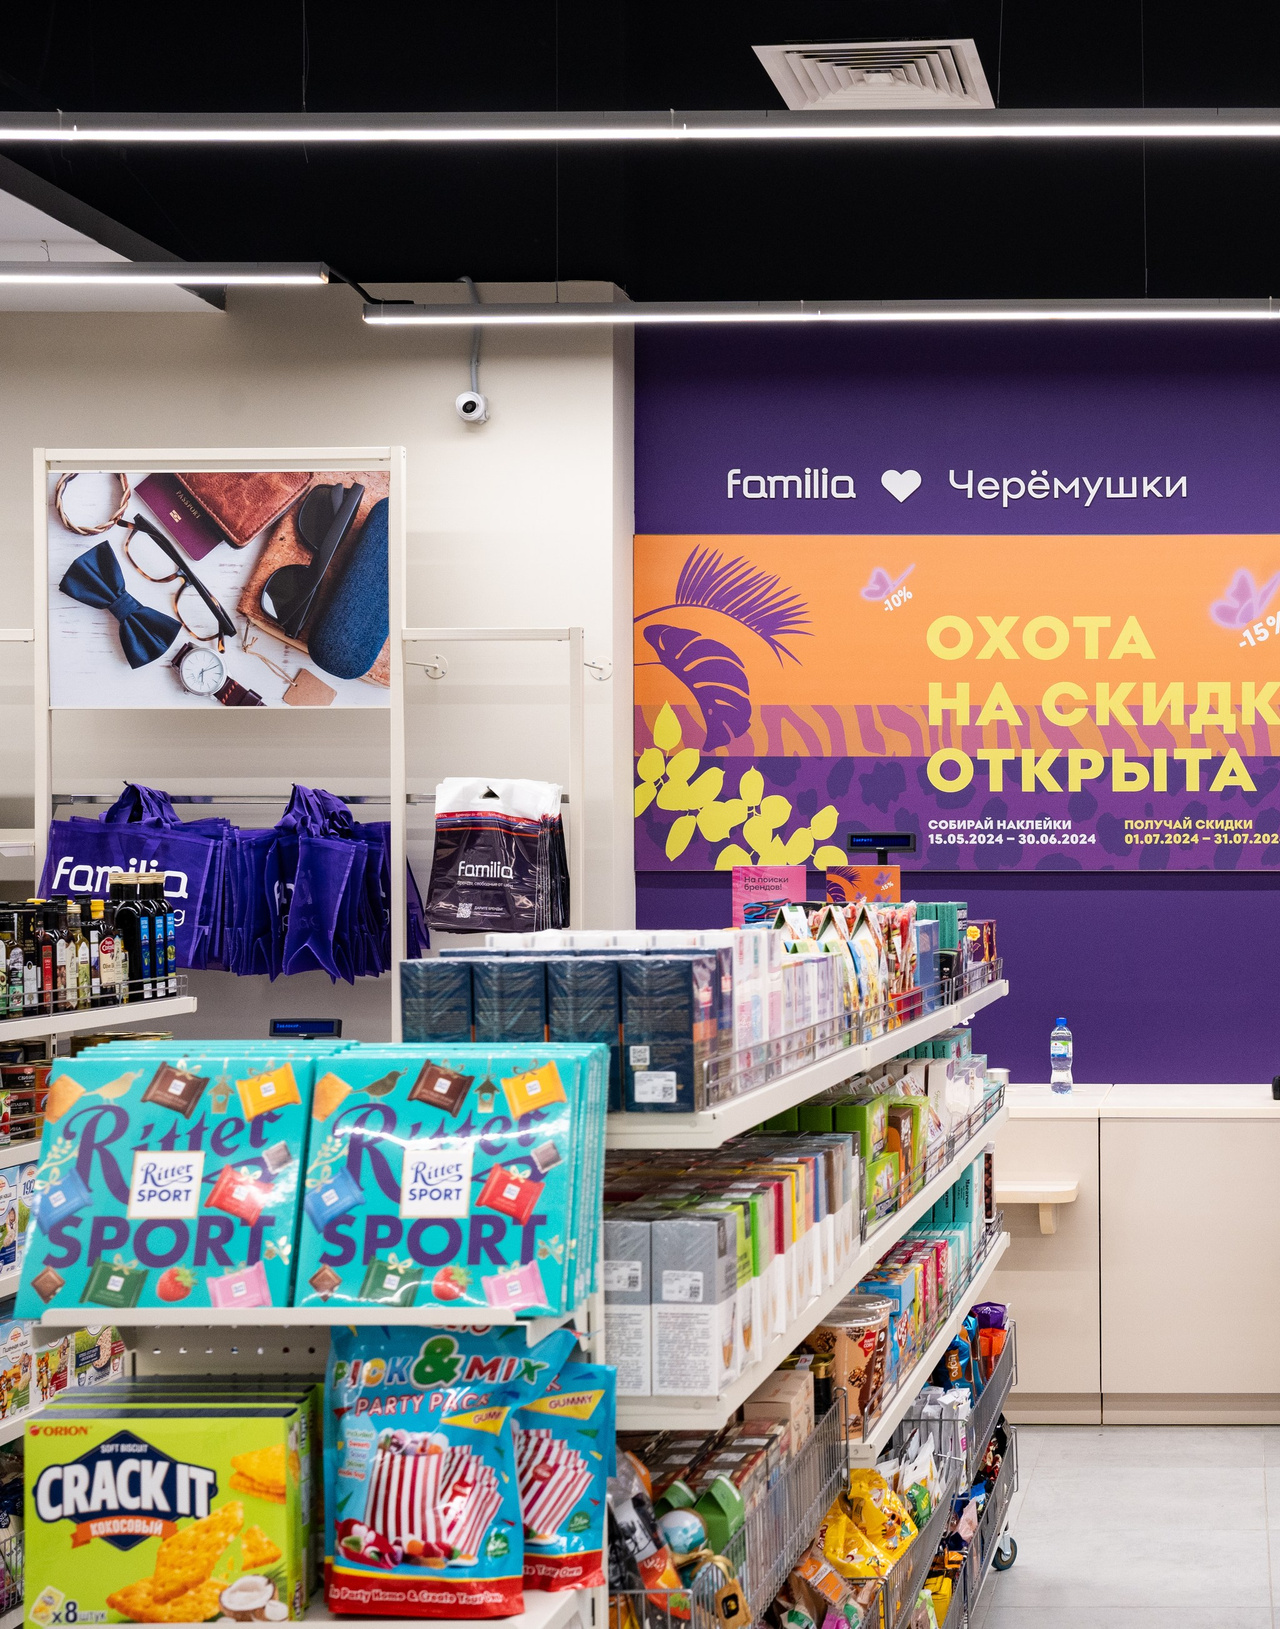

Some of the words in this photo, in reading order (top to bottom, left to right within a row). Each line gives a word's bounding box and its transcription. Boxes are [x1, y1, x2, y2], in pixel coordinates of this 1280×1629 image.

[727, 468, 857, 500] familia
[949, 468, 1188, 507] Черёмушки
[176, 490, 201, 519] PASSPORT
[883, 585, 913, 613] -10%
[926, 615, 1156, 660] ОХОТА
[928, 682, 1023, 726] НА
[926, 748, 1258, 793] ОТКРЫТА
[928, 816, 994, 830] СОБИРАЙ
[997, 816, 1072, 830] НАКЛЕЙКИ
[1124, 816, 1192, 830] ПОЛУЧАЙ
[1195, 818, 1253, 830] СКИДКИ
[928, 834, 1004, 846] 15.05.2024
[1018, 834, 1097, 846] 30.06.2024
[1124, 833, 1200, 845] 01.07.2024
[53, 856, 188, 899] fama
[458, 861, 513, 879] familia
[744, 883, 783, 891] брендов!
[140, 1162, 193, 1187] Ritter
[411, 1161, 464, 1186] Ritter
[137, 1189, 192, 1203] SPORT
[408, 1188, 463, 1202] SPORT
[42, 1215, 276, 1269] SPORT
[319, 1215, 547, 1267] SPORT
[333, 1356, 411, 1388] PICK
[464, 1356, 549, 1386] MIX
[355, 1394, 425, 1416] PARTY
[430, 1392, 494, 1411] PACK
[548, 1394, 593, 1409] GUMMY
[43, 1425, 88, 1436] ORION
[100, 1444, 119, 1454] SOFT
[121, 1444, 149, 1454] BISCUIT
[36, 1458, 172, 1521] CRACK
[176, 1461, 216, 1520] IT
[90, 1518, 163, 1536] КОКОСОВЫЙ
[341, 1586, 370, 1603] Party
[372, 1590, 406, 1601] Home
[419, 1590, 456, 1602] Create
